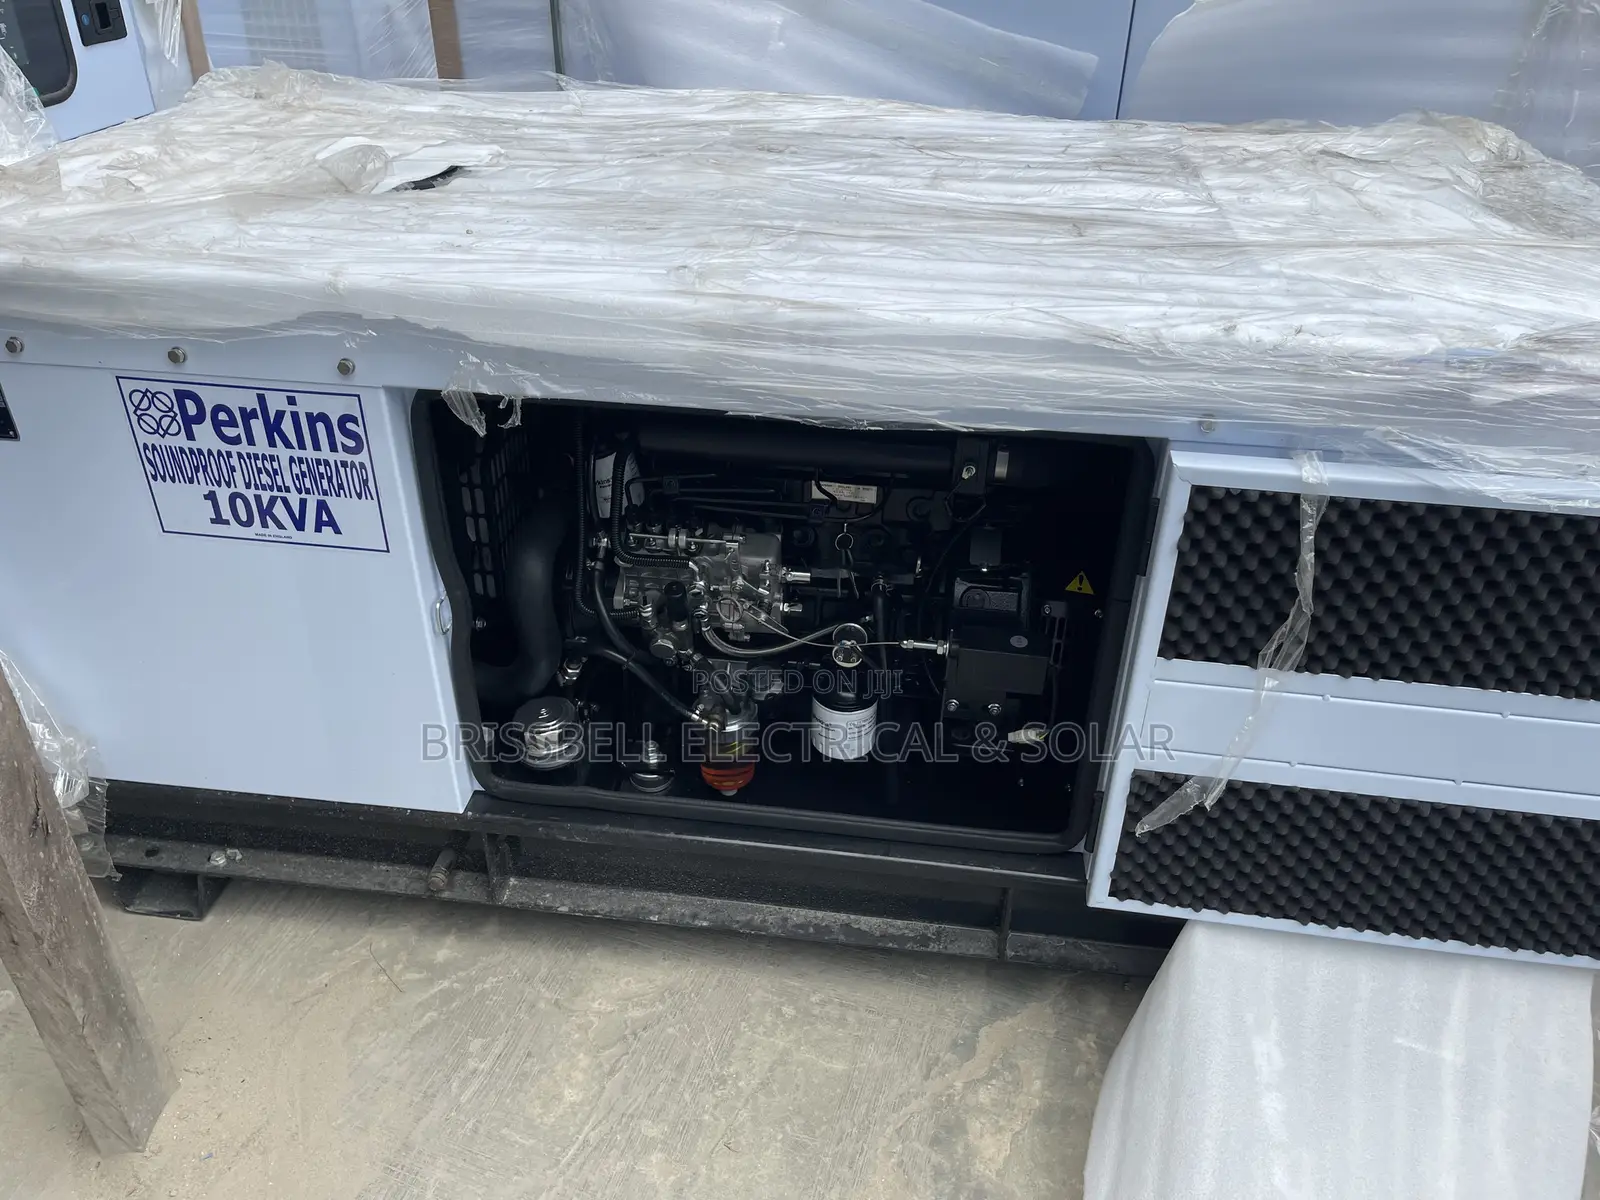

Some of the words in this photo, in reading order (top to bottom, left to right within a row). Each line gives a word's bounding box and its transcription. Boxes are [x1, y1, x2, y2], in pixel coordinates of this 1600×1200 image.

[173, 389, 364, 455] Perkins
[142, 442, 238, 489] SOUNDPROOF
[236, 451, 291, 493] DIESEL
[288, 455, 374, 500] GENERATOR
[203, 490, 342, 535] 10KVA
